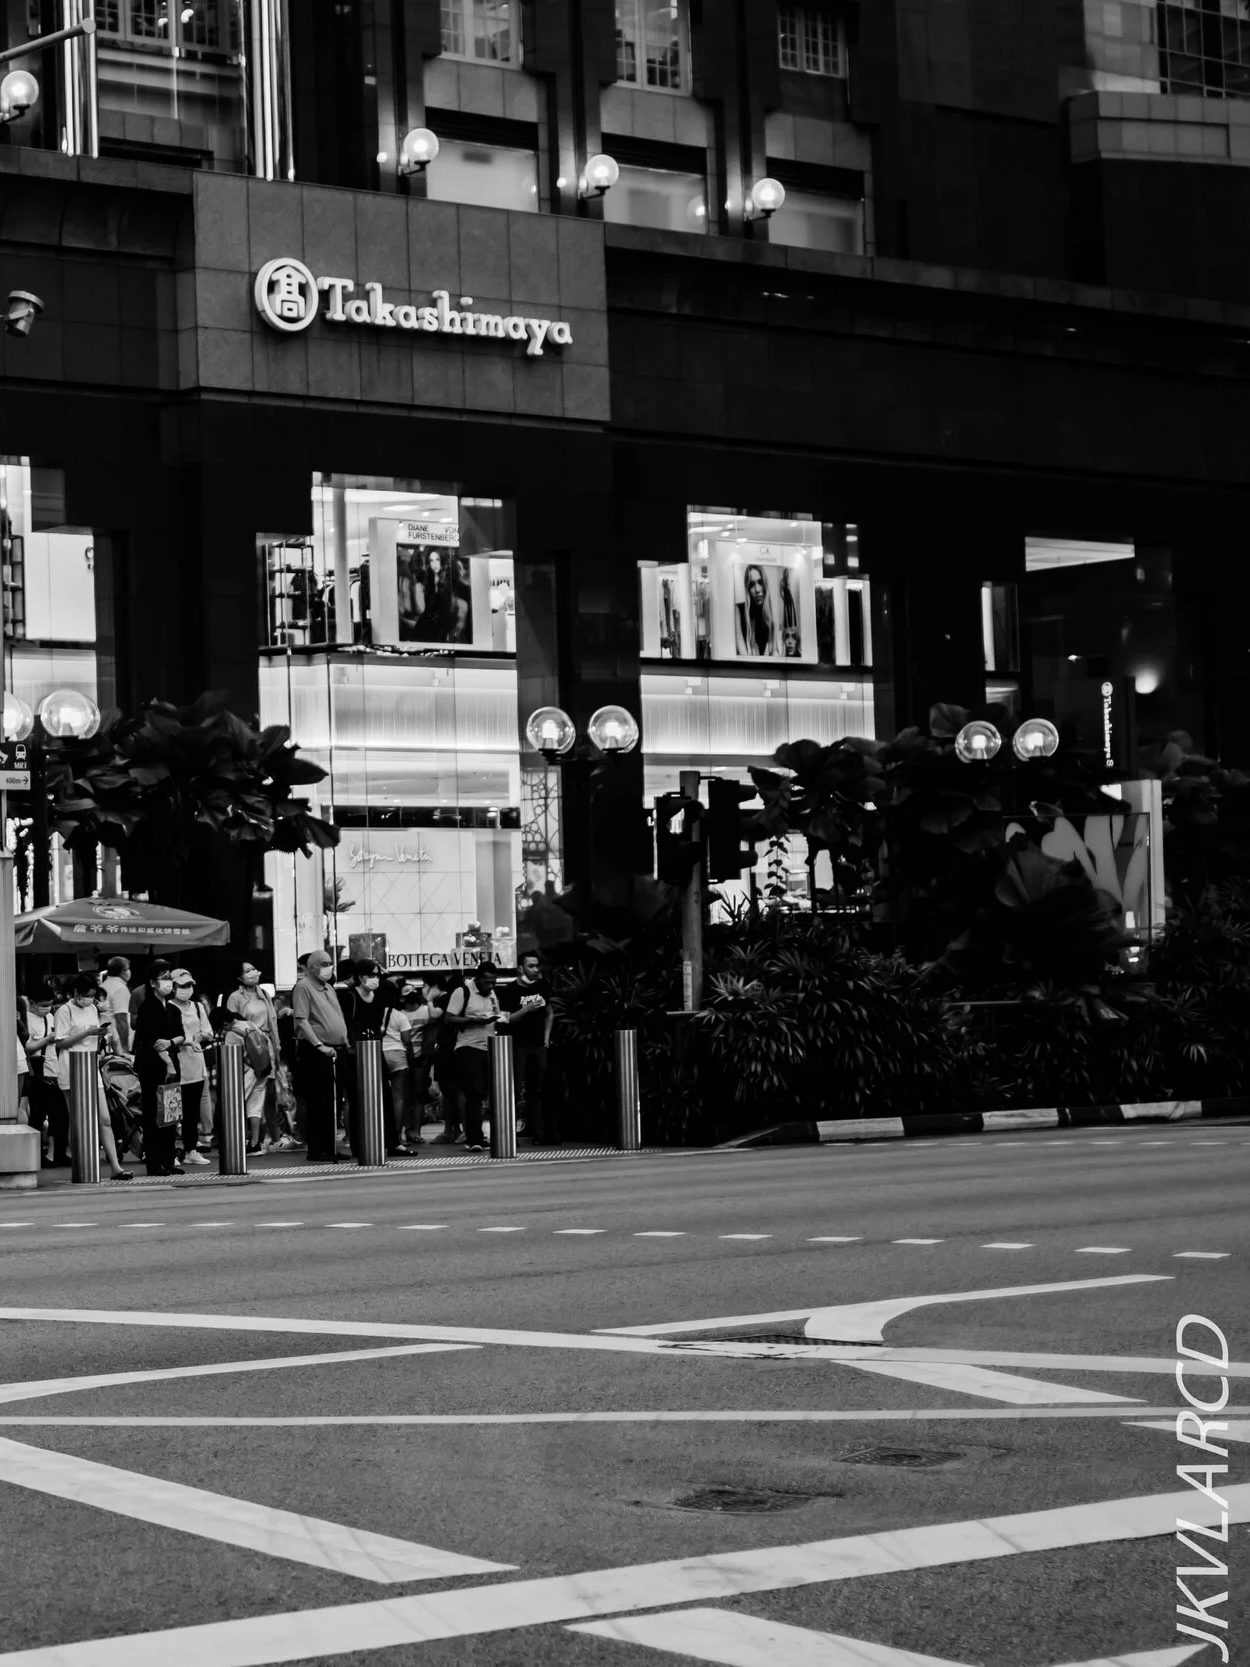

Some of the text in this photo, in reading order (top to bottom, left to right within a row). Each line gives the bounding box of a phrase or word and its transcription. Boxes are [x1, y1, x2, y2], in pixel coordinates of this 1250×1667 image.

[317, 275, 573, 356] Takashimaya
[408, 523, 429, 532] DIANE
[1103, 695, 1113, 759] Takashimaya
[388, 951, 503, 968] BOTTEGA VENETA
